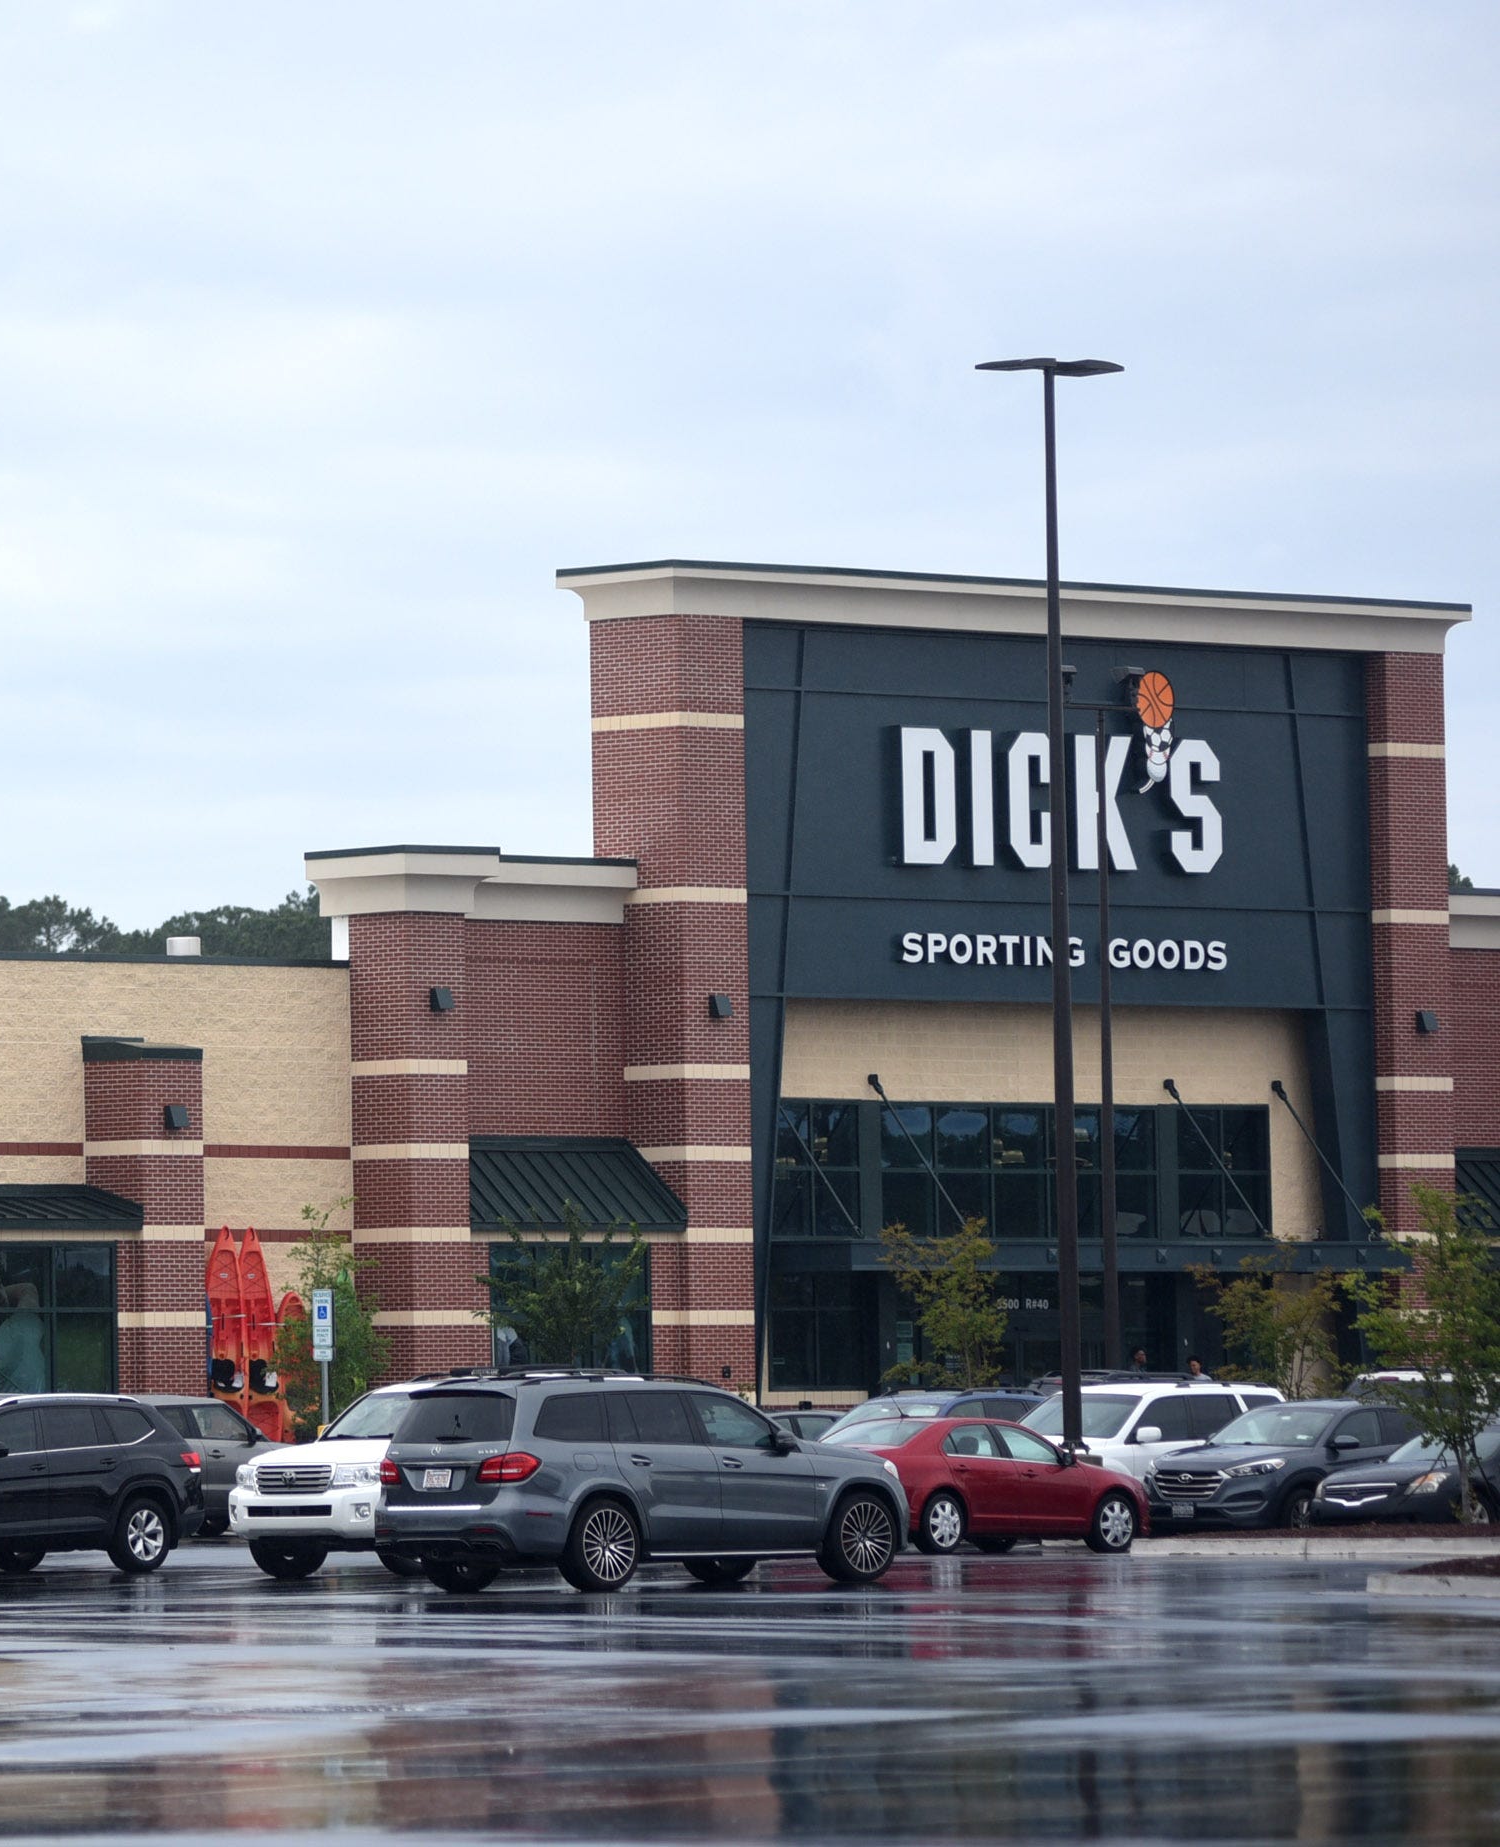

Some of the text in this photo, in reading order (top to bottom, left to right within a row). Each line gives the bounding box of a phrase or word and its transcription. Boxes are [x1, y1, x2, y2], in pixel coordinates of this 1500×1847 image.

[901, 726, 1223, 873] DICK'S
[902, 932, 1227, 971] SPORTING GOODS
